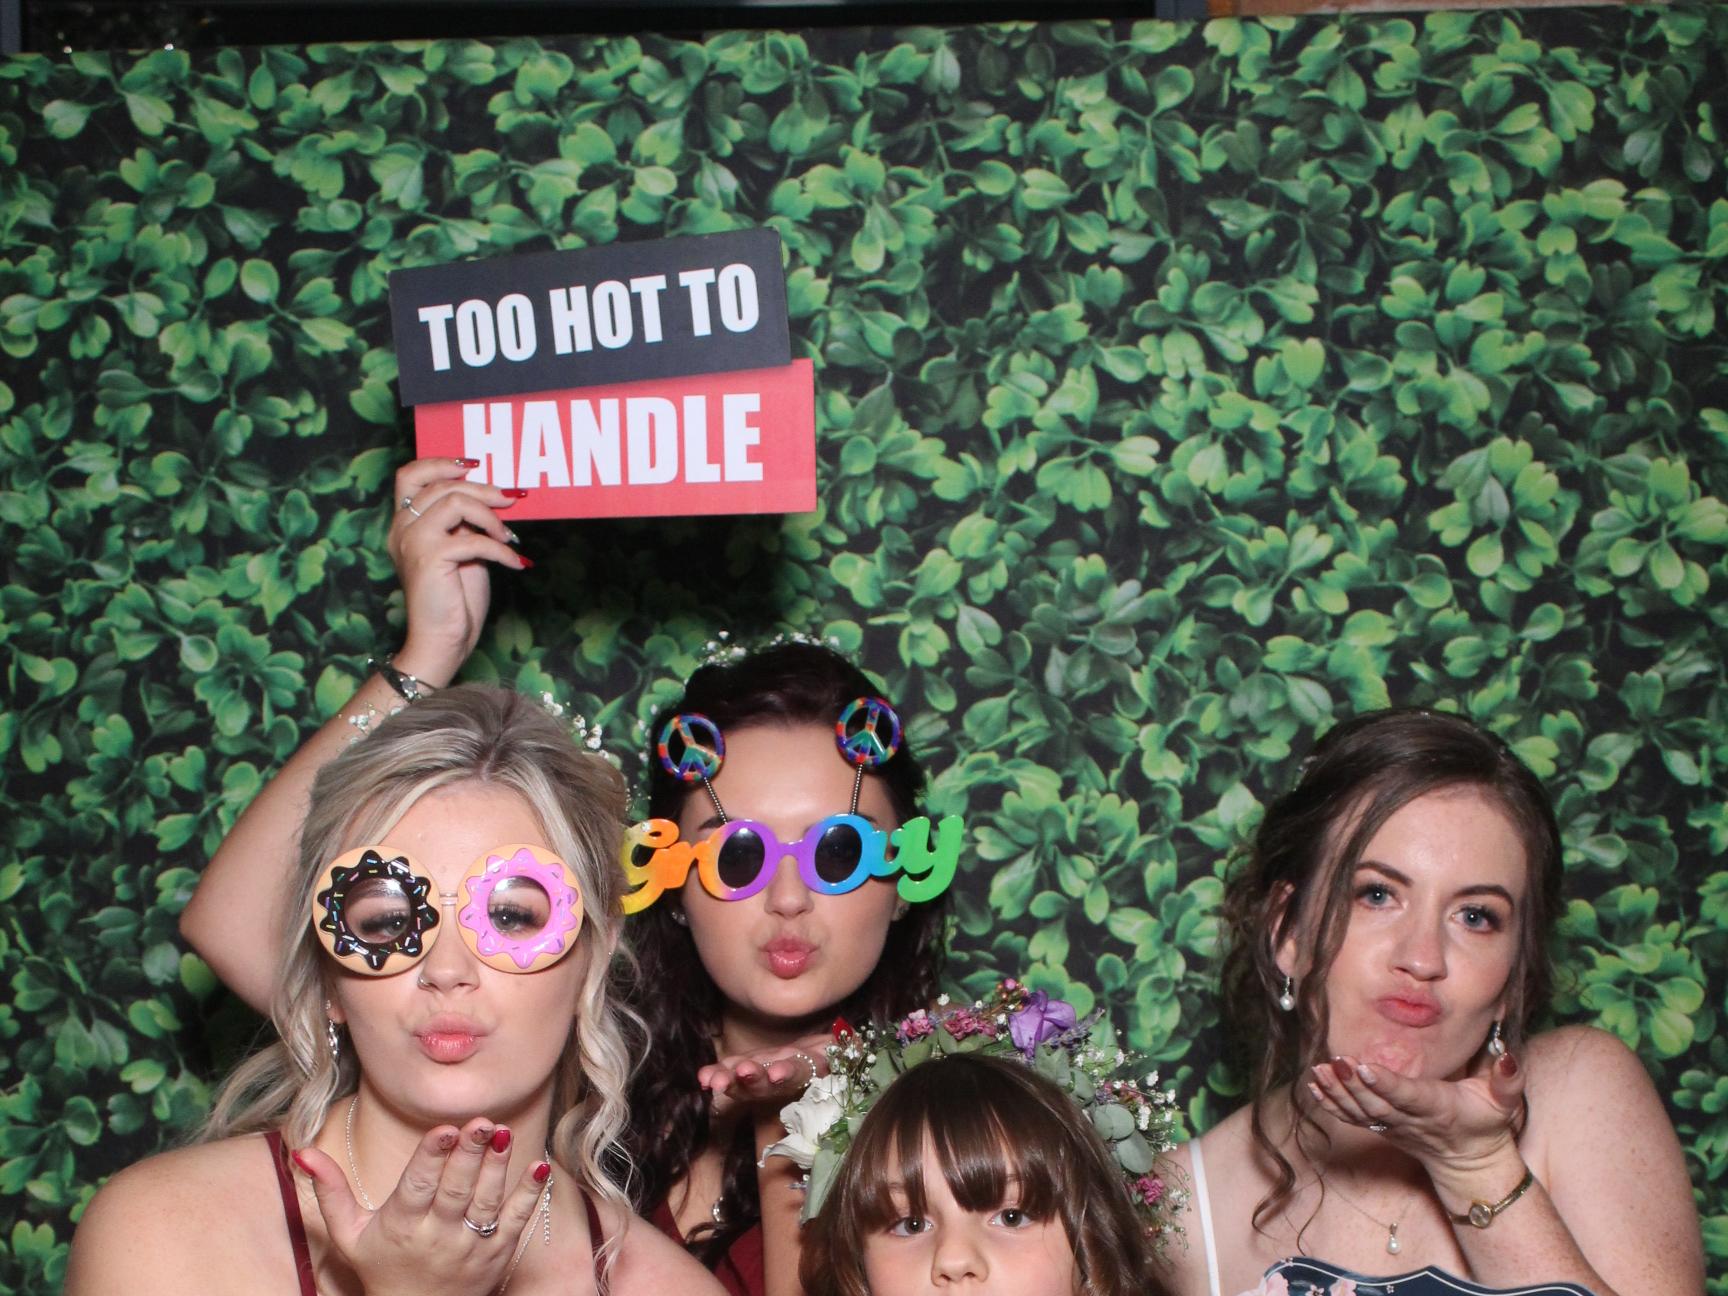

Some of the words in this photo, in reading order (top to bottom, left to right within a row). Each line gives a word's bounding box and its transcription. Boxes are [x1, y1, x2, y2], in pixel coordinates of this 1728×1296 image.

[418, 293, 537, 371] TOO
[549, 275, 667, 355] HOT
[679, 263, 760, 337] TO
[462, 393, 764, 489] HANDLE
